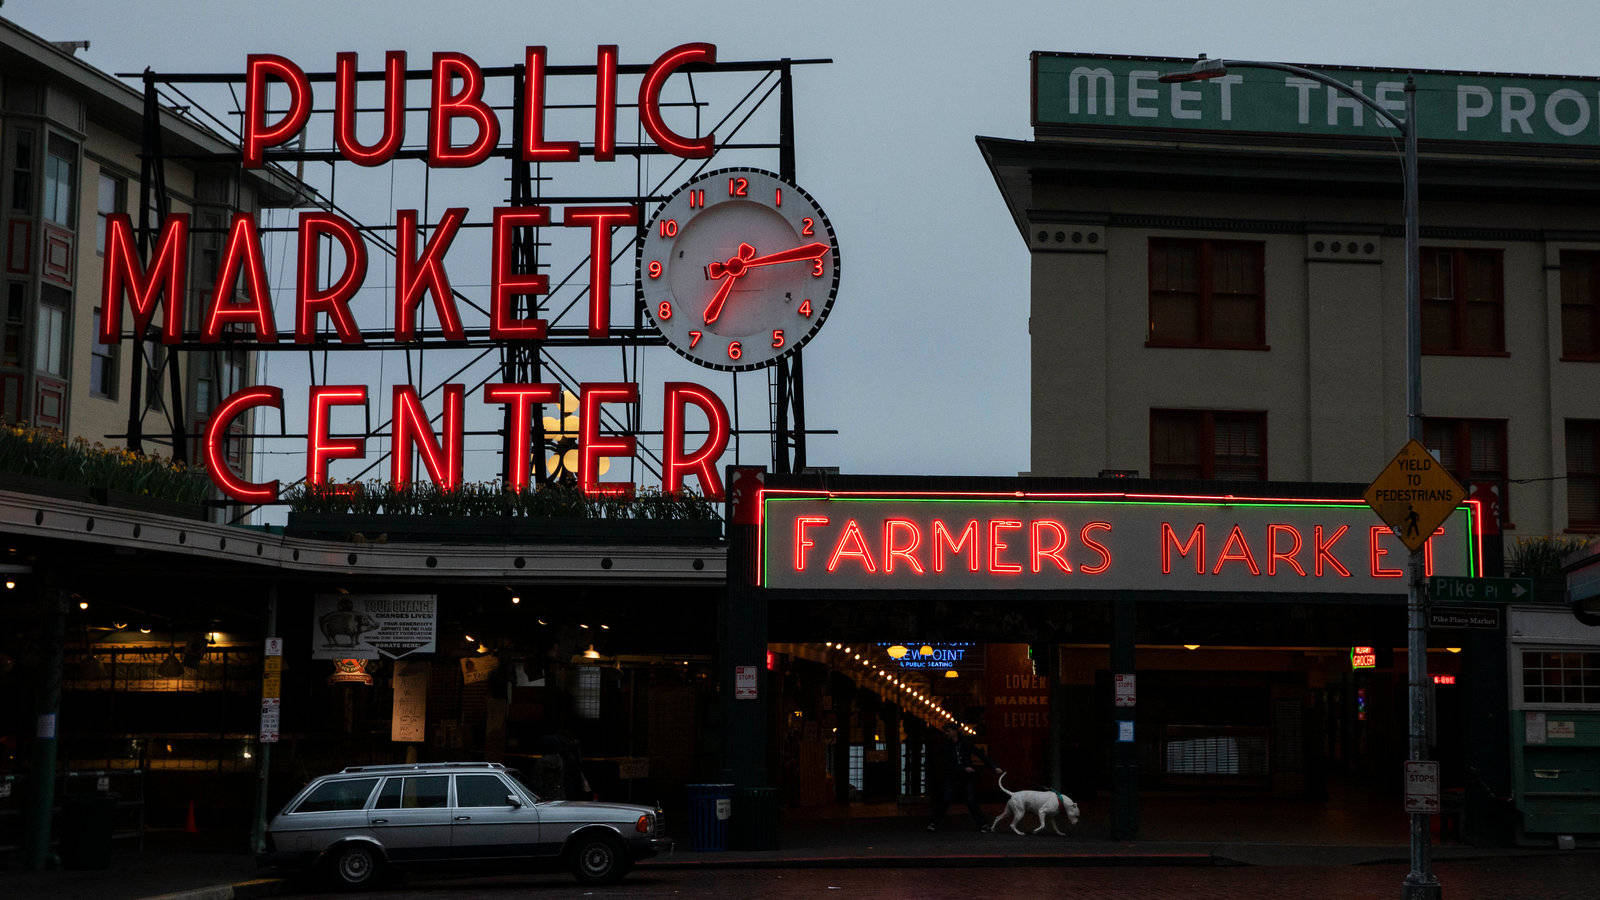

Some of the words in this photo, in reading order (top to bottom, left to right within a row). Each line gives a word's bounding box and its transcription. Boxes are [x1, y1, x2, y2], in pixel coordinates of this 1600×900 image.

[242, 43, 717, 169] PUBLIC
[1068, 66, 1243, 121] MEET
[1285, 76, 1406, 129] THE
[1456, 84, 1600, 137] PRO
[729, 177, 748, 197] 12
[689, 189, 705, 208] 11
[775, 188, 782, 207] 1
[659, 218, 678, 238] 10
[801, 217, 814, 236] 2
[102, 206, 639, 344] MARKET
[648, 260, 663, 279] 9
[811, 258, 824, 277] 3
[658, 301, 672, 320] 8
[798, 299, 812, 318] 4
[688, 331, 702, 349] 7
[772, 329, 784, 348] 5
[728, 341, 742, 360] 6
[203, 381, 731, 502] CENTER
[1399, 459, 1431, 471] YIELD
[1407, 474, 1421, 486] TO
[1375, 489, 1453, 501] PEDESTRIANS
[795, 517, 1112, 574] FARMERS
[1161, 522, 1444, 577] MARKET
[1435, 578, 1475, 599] Pike
[1485, 585, 1499, 599] Pl
[393, 600, 433, 612] CHANGE
[1432, 615, 1448, 623] Pike
[1005, 674, 1047, 689] LOWER
[993, 696, 1048, 705] MARKE
[1410, 774, 1435, 783] STOPS
